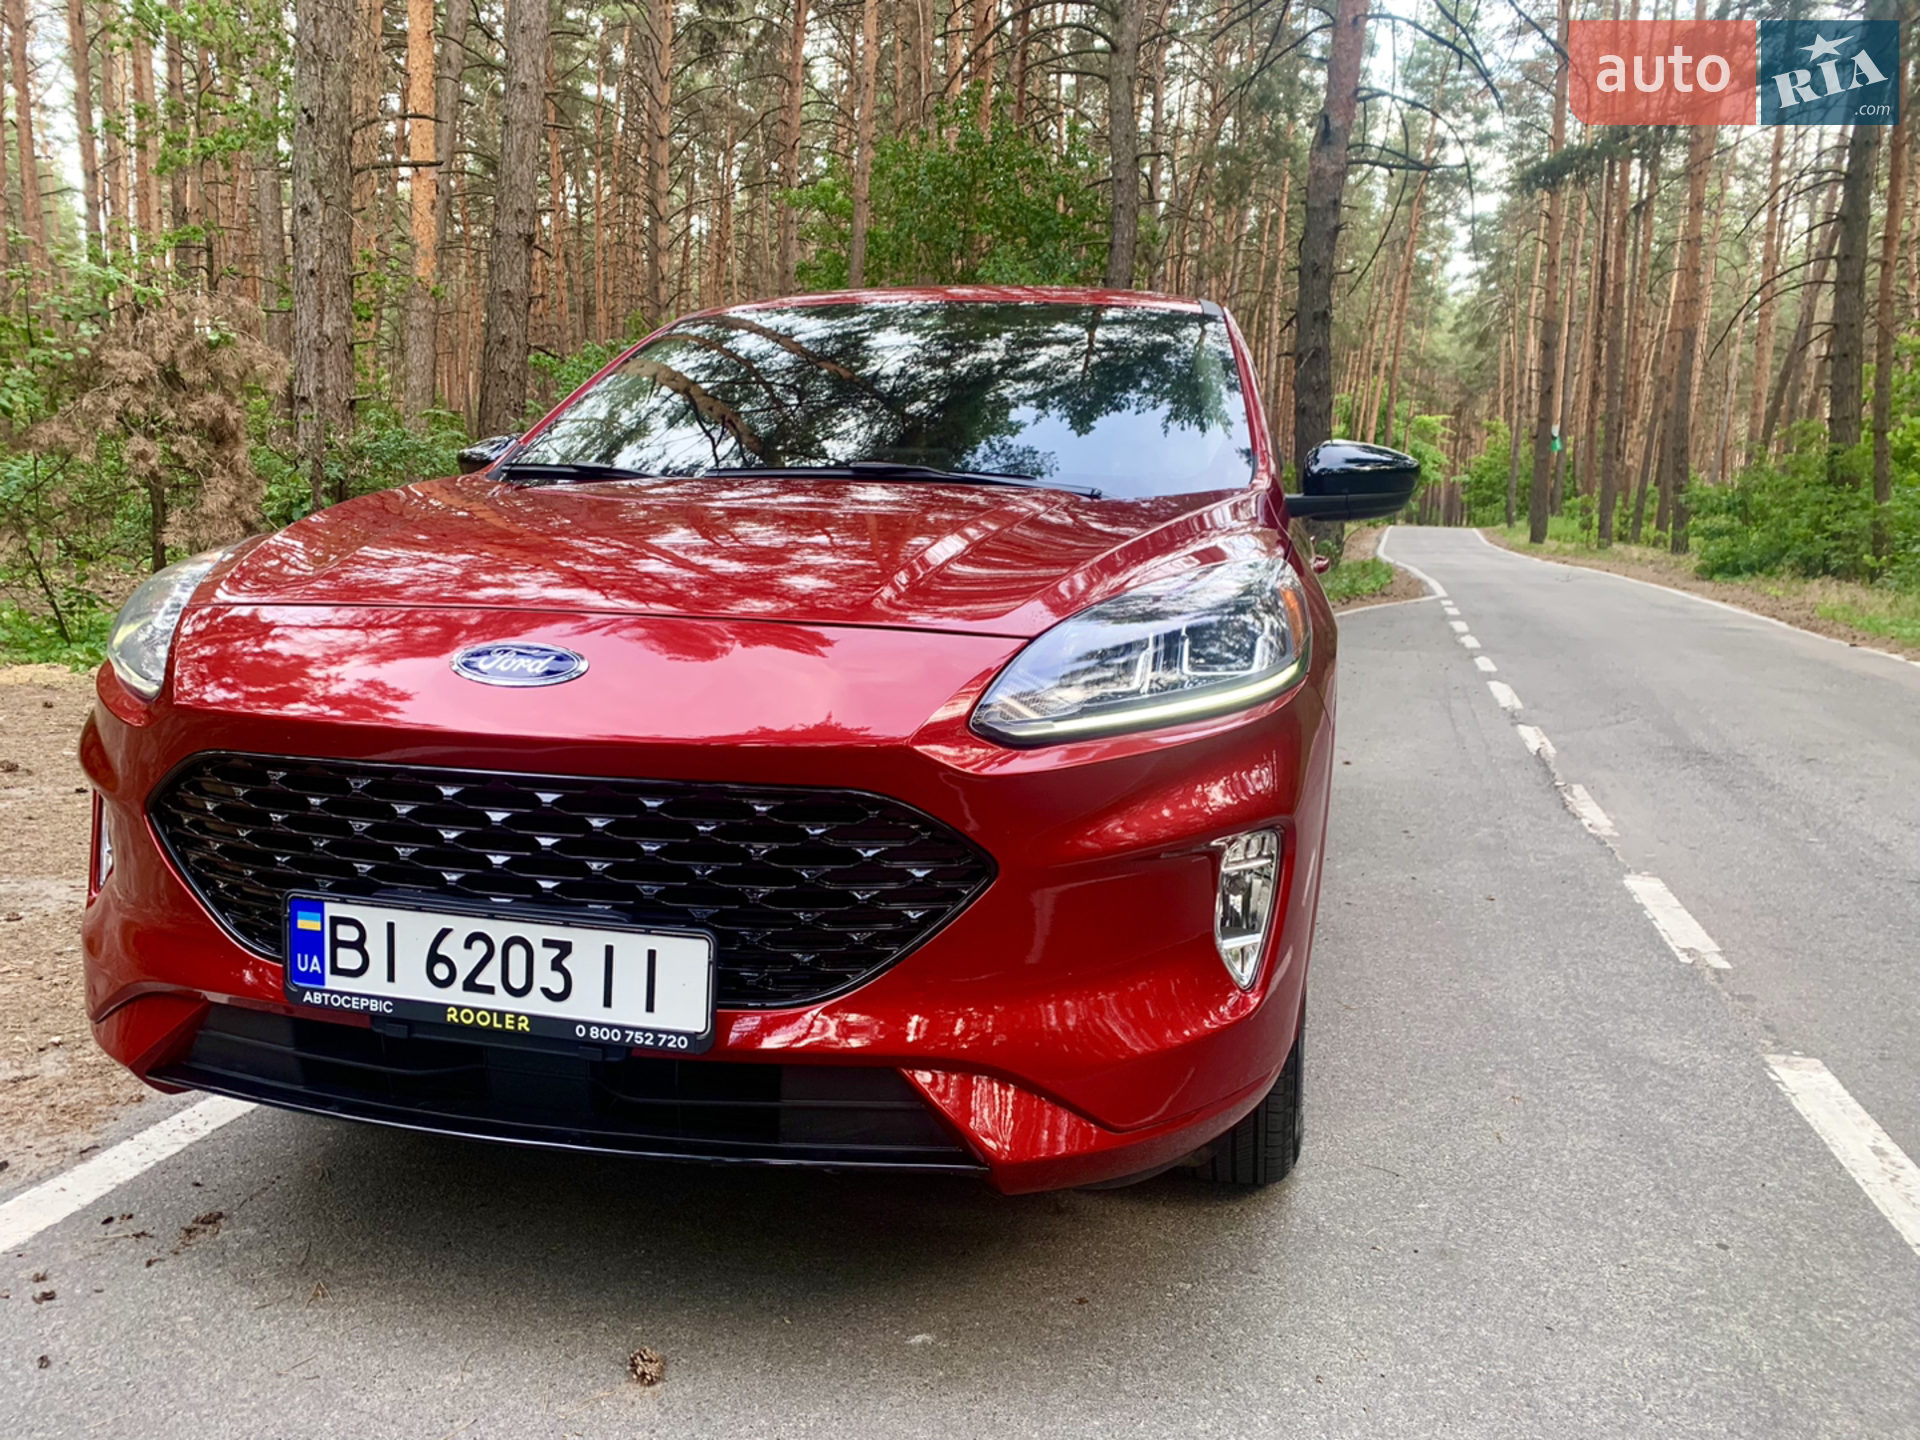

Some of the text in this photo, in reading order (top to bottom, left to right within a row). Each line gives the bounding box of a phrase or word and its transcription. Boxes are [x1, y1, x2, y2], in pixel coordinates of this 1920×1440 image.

[477, 647, 556, 673] Ford
[297, 953, 322, 974] UA
[329, 915, 396, 984] BI
[425, 927, 573, 1002] 6203
[302, 990, 394, 1013] АВТОСЕРВІС
[446, 1006, 531, 1032] ROOLER
[575, 1024, 689, 1049] 0 800 752 720
